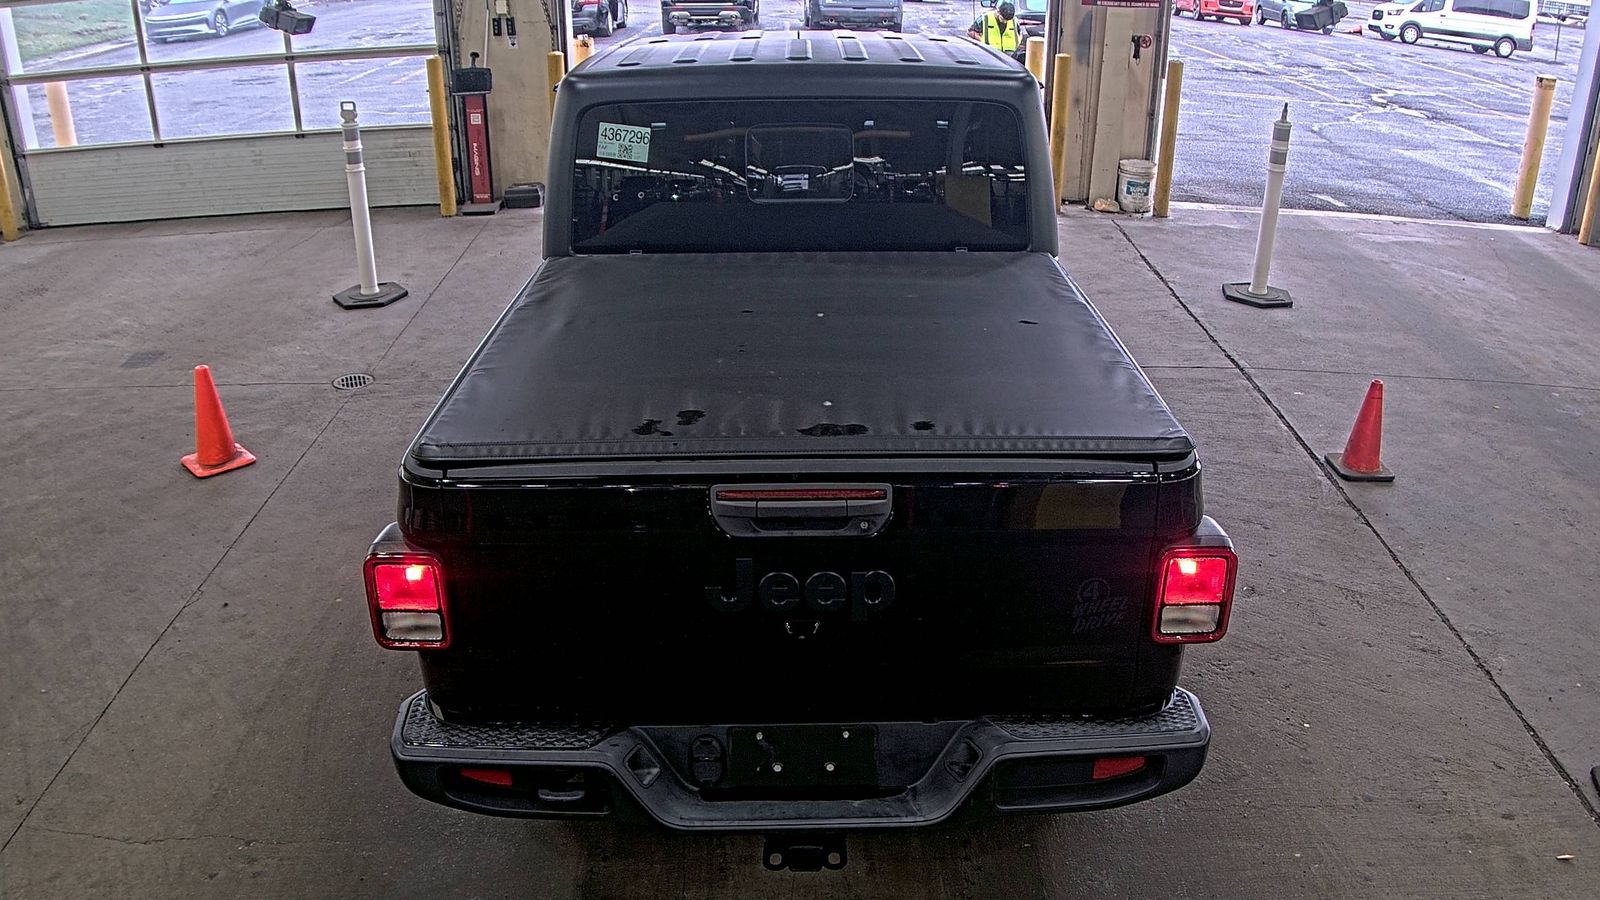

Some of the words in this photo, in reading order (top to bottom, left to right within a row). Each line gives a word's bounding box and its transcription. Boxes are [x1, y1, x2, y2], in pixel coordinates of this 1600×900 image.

[600, 127, 650, 145] 4367296
[705, 557, 896, 622] Jeep
[1071, 596, 1128, 619] WHEEL
[1071, 611, 1127, 634] DRIVE
